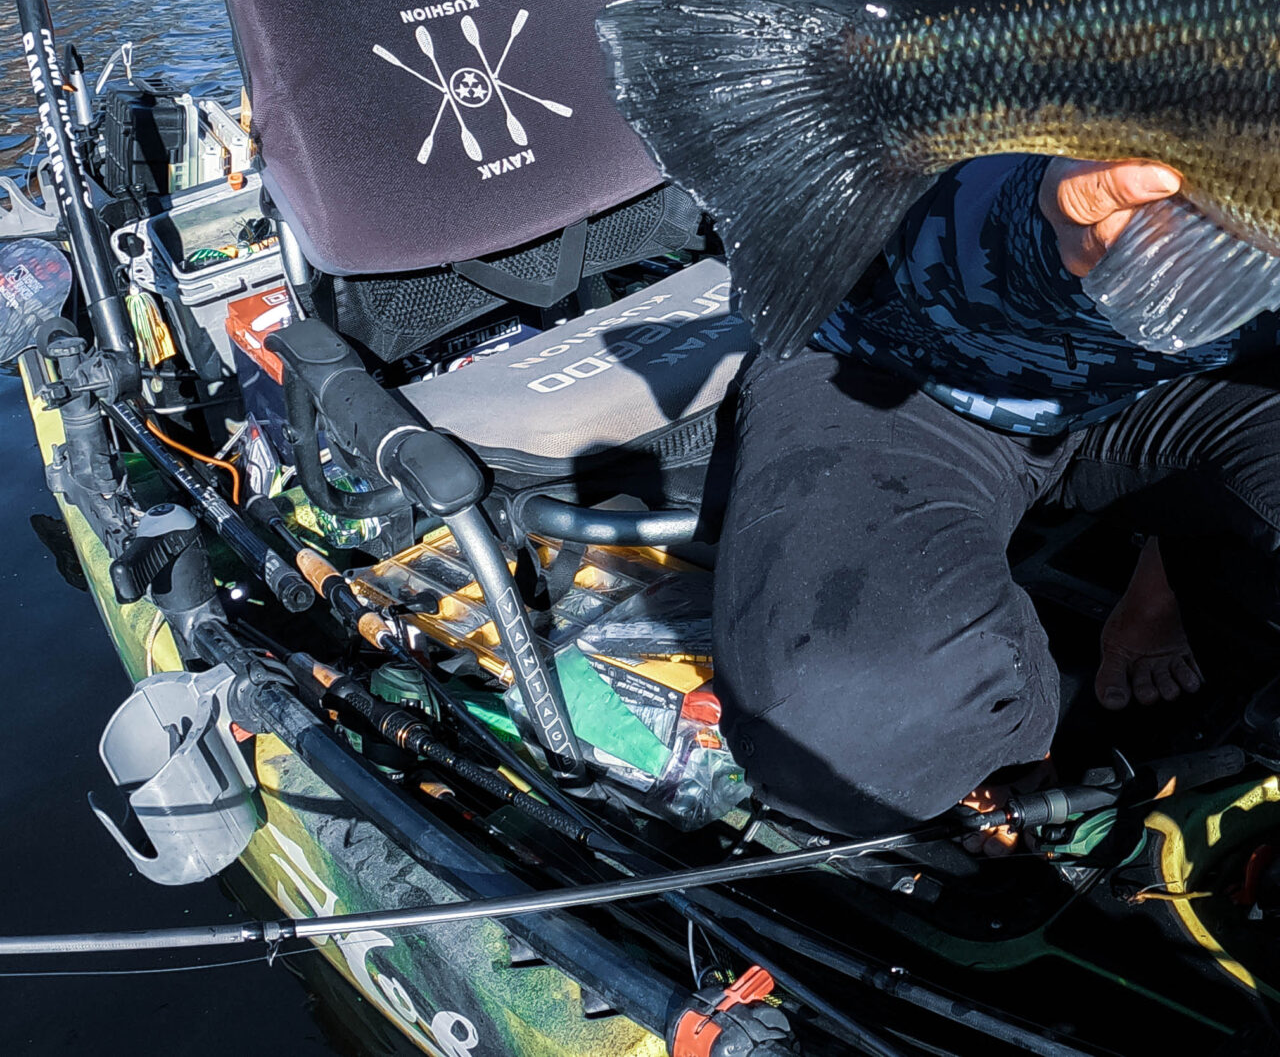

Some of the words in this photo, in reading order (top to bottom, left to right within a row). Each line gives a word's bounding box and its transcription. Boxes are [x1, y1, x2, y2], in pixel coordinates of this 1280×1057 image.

[476, 148, 536, 180] KAYAK
[438, 318, 518, 356] ITHIUM
[508, 294, 672, 369] KUSHION
[647, 311, 746, 367] AYAK
[502, 601, 573, 768] VANTAGE
